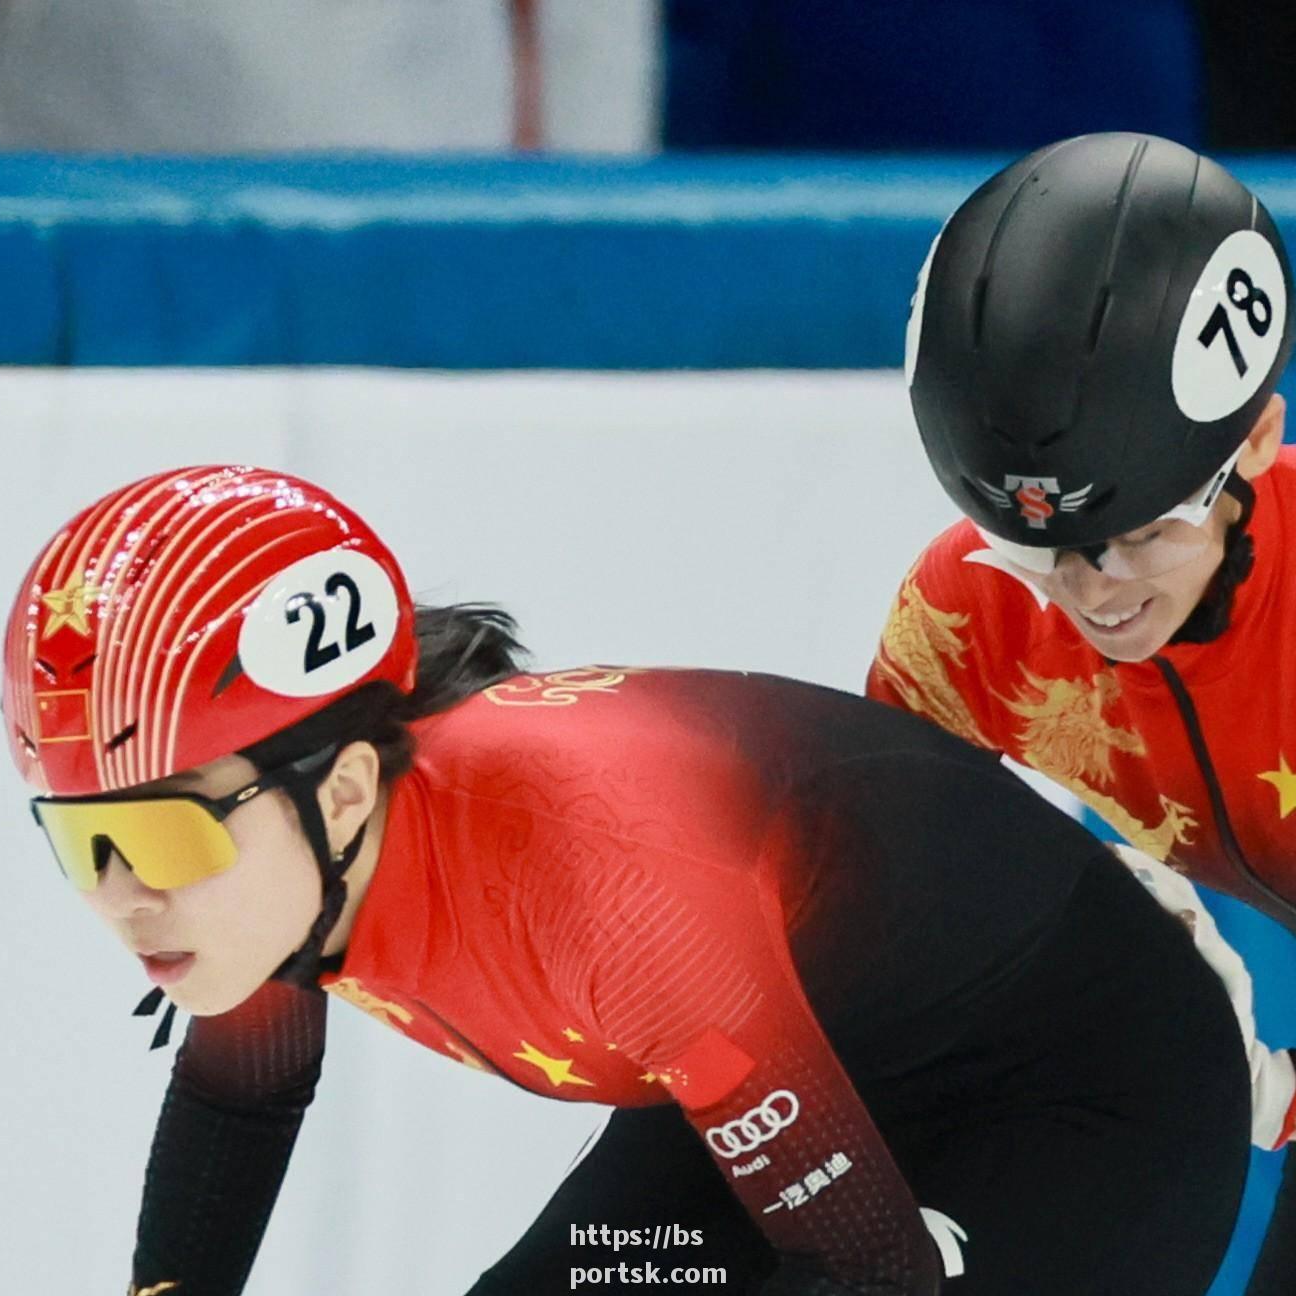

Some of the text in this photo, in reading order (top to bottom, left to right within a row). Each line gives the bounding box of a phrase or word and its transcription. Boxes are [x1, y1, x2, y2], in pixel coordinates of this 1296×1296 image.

[1198, 267, 1272, 380] 78
[286, 571, 377, 674] 22
[732, 1154, 771, 1179] Audi
[762, 1151, 853, 1214] 一汽奥迪
